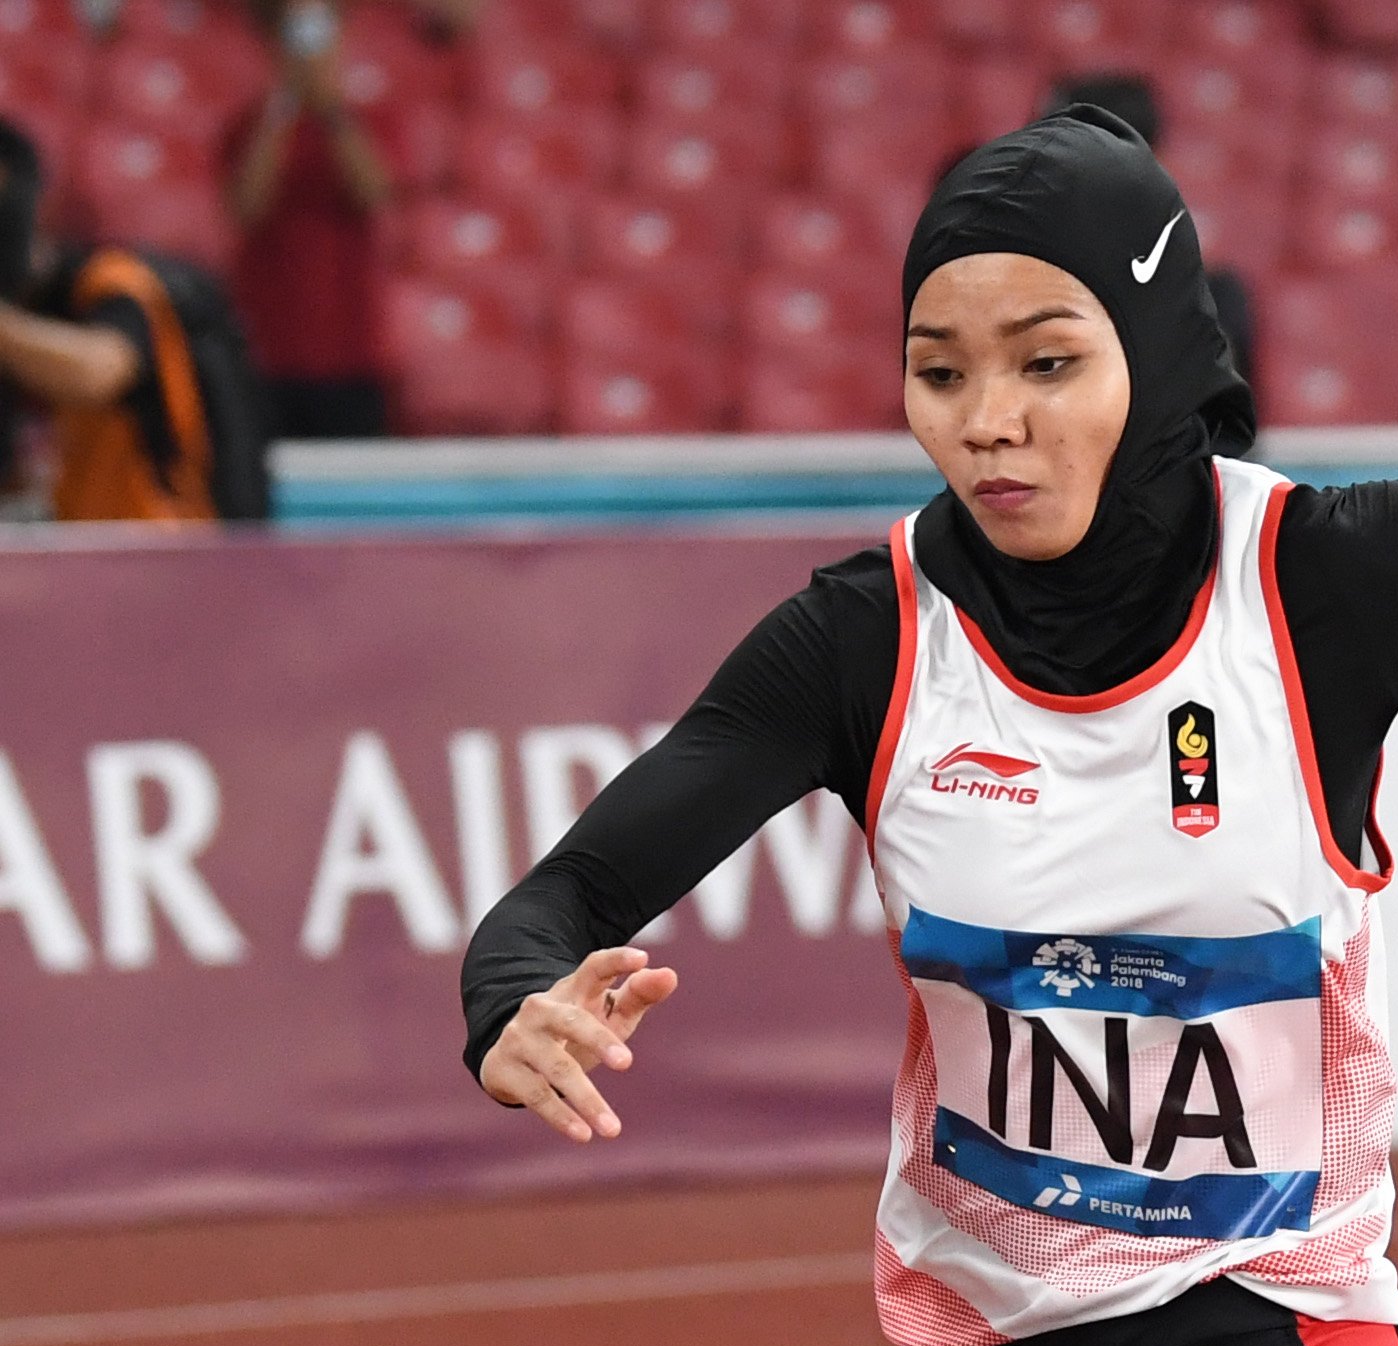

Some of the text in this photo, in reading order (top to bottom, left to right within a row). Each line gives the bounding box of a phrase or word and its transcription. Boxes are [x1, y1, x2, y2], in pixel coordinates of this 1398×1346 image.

[930, 773, 1040, 805] LI-NING
[1111, 953, 1165, 967] Jakarta
[1110, 964, 1187, 988] Palembang
[1110, 975, 1144, 989] 2018
[986, 1004, 1258, 1173] INA
[1089, 1197, 1193, 1222] PERTAMINA
